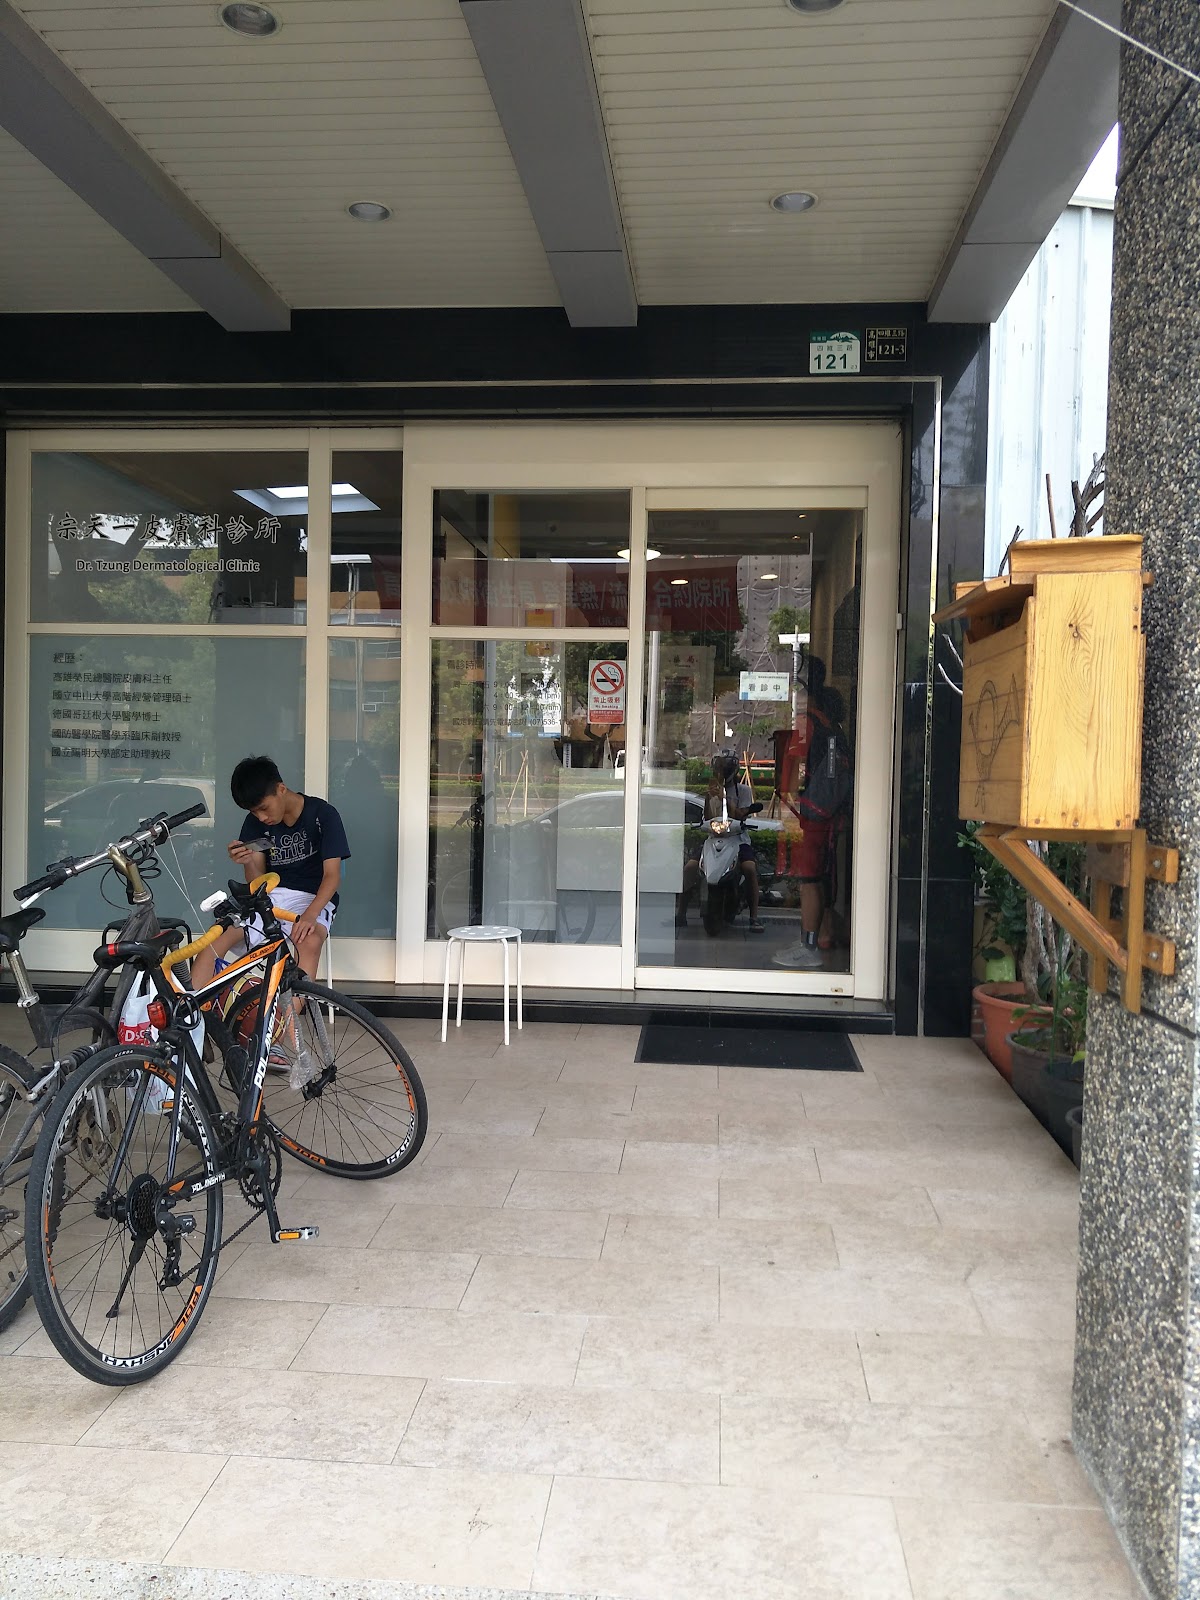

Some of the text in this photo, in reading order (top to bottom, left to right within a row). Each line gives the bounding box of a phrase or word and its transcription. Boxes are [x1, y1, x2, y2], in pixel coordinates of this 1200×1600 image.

[878, 344, 905, 355] 121-3
[813, 353, 848, 370] 121
[56, 511, 282, 544] 宗天一皮膚科診所
[76, 558, 261, 574] Dr. Tzung Dermatological Clinic
